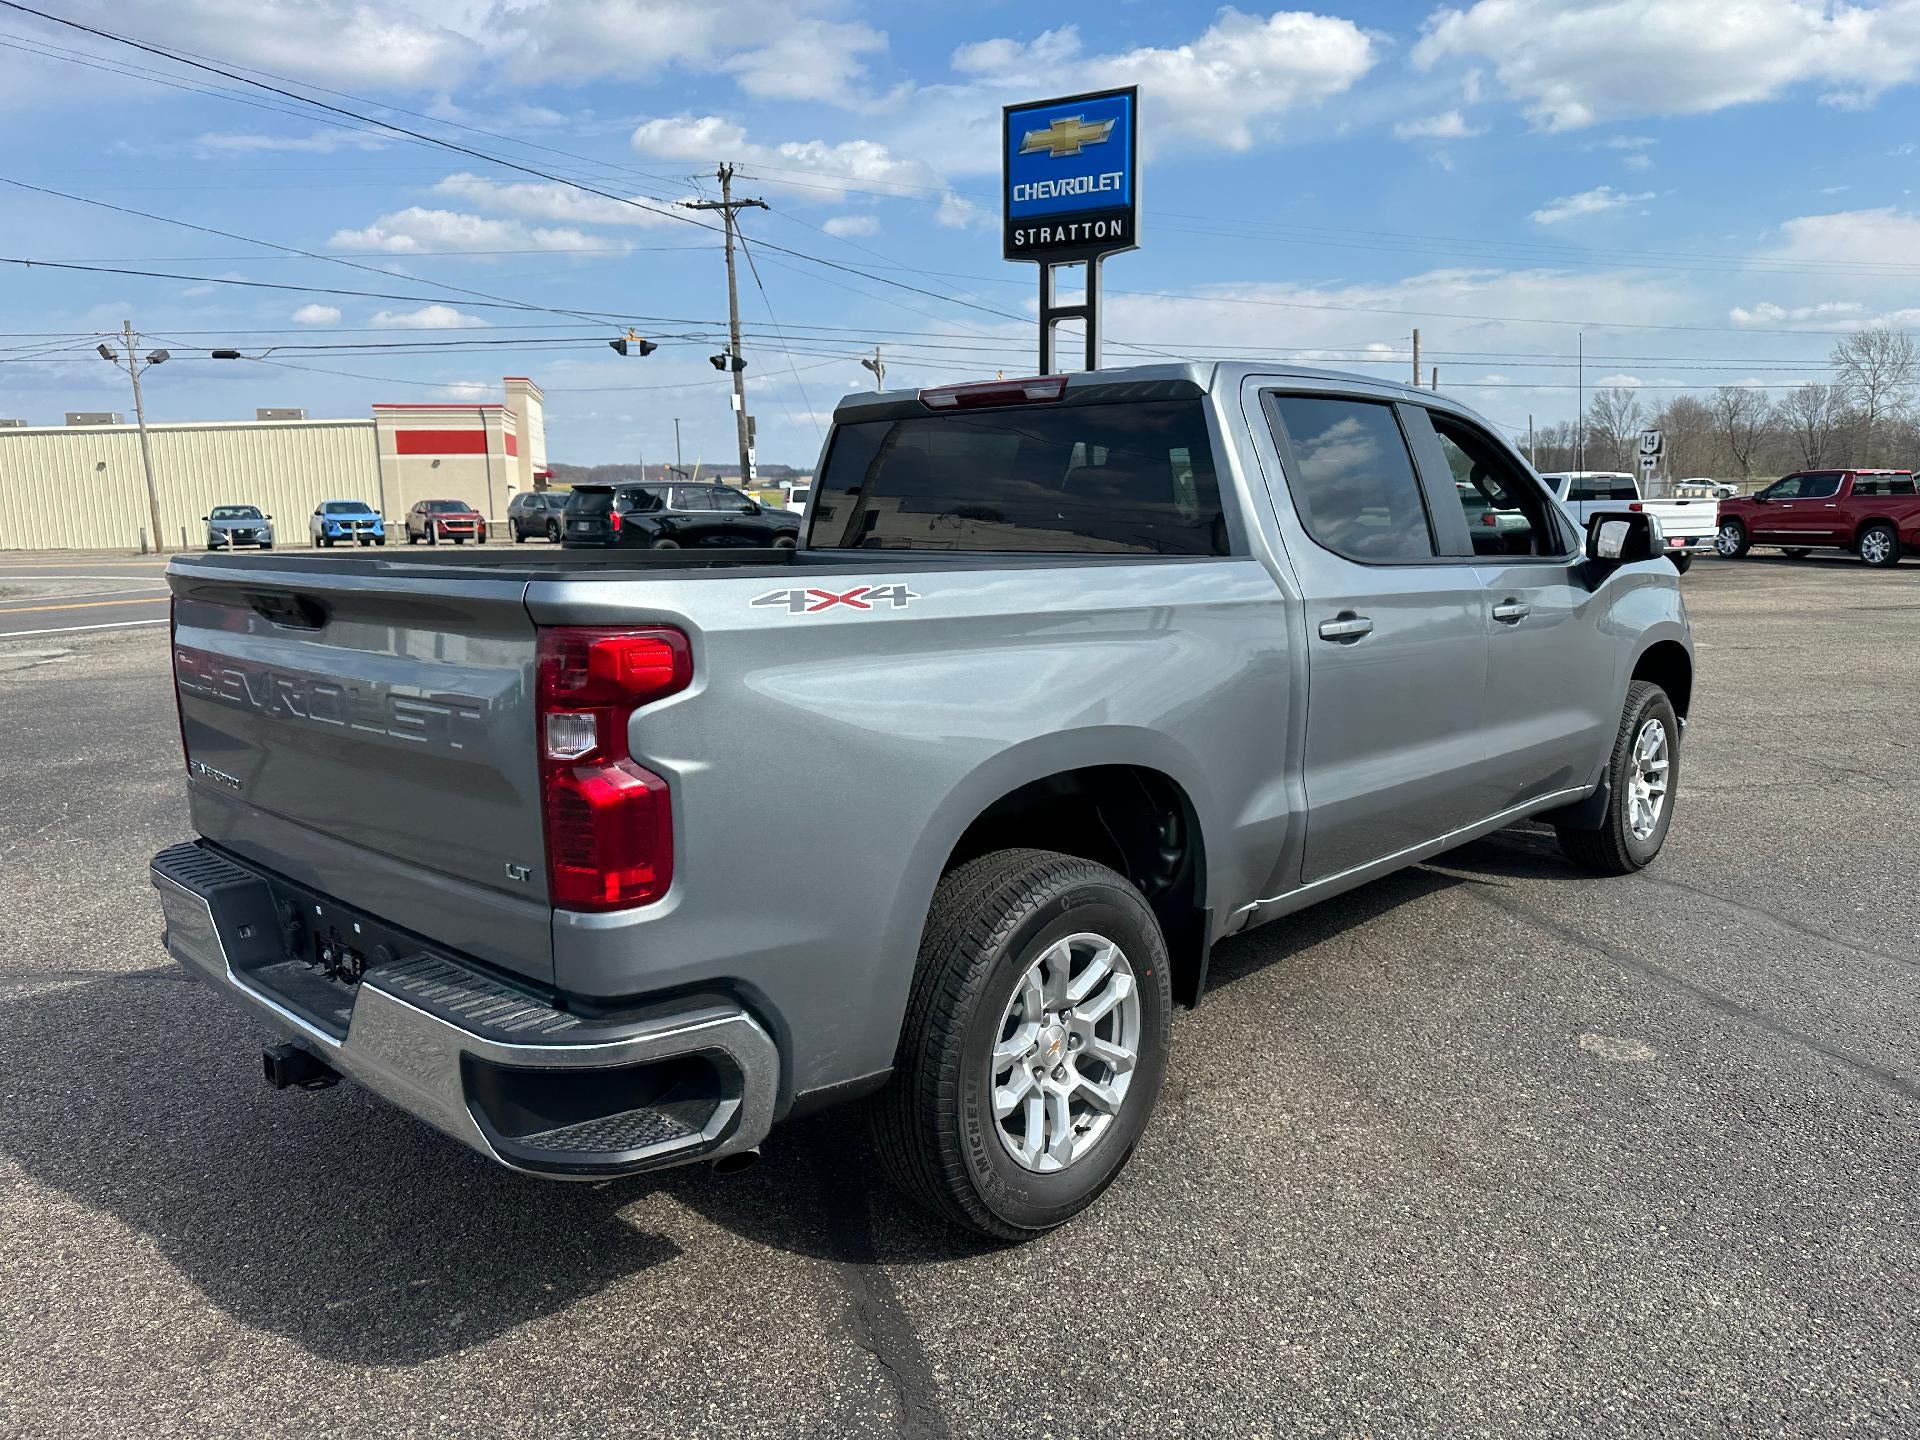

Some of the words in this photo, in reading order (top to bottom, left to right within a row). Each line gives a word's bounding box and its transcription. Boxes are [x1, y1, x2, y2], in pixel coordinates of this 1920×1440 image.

[1013, 171, 1123, 202] CHEVROLET
[1014, 219, 1122, 246] STRATTON
[1644, 435, 1655, 448] 14
[176, 650, 484, 749] CHEVROLET
[505, 863, 530, 882] LT
